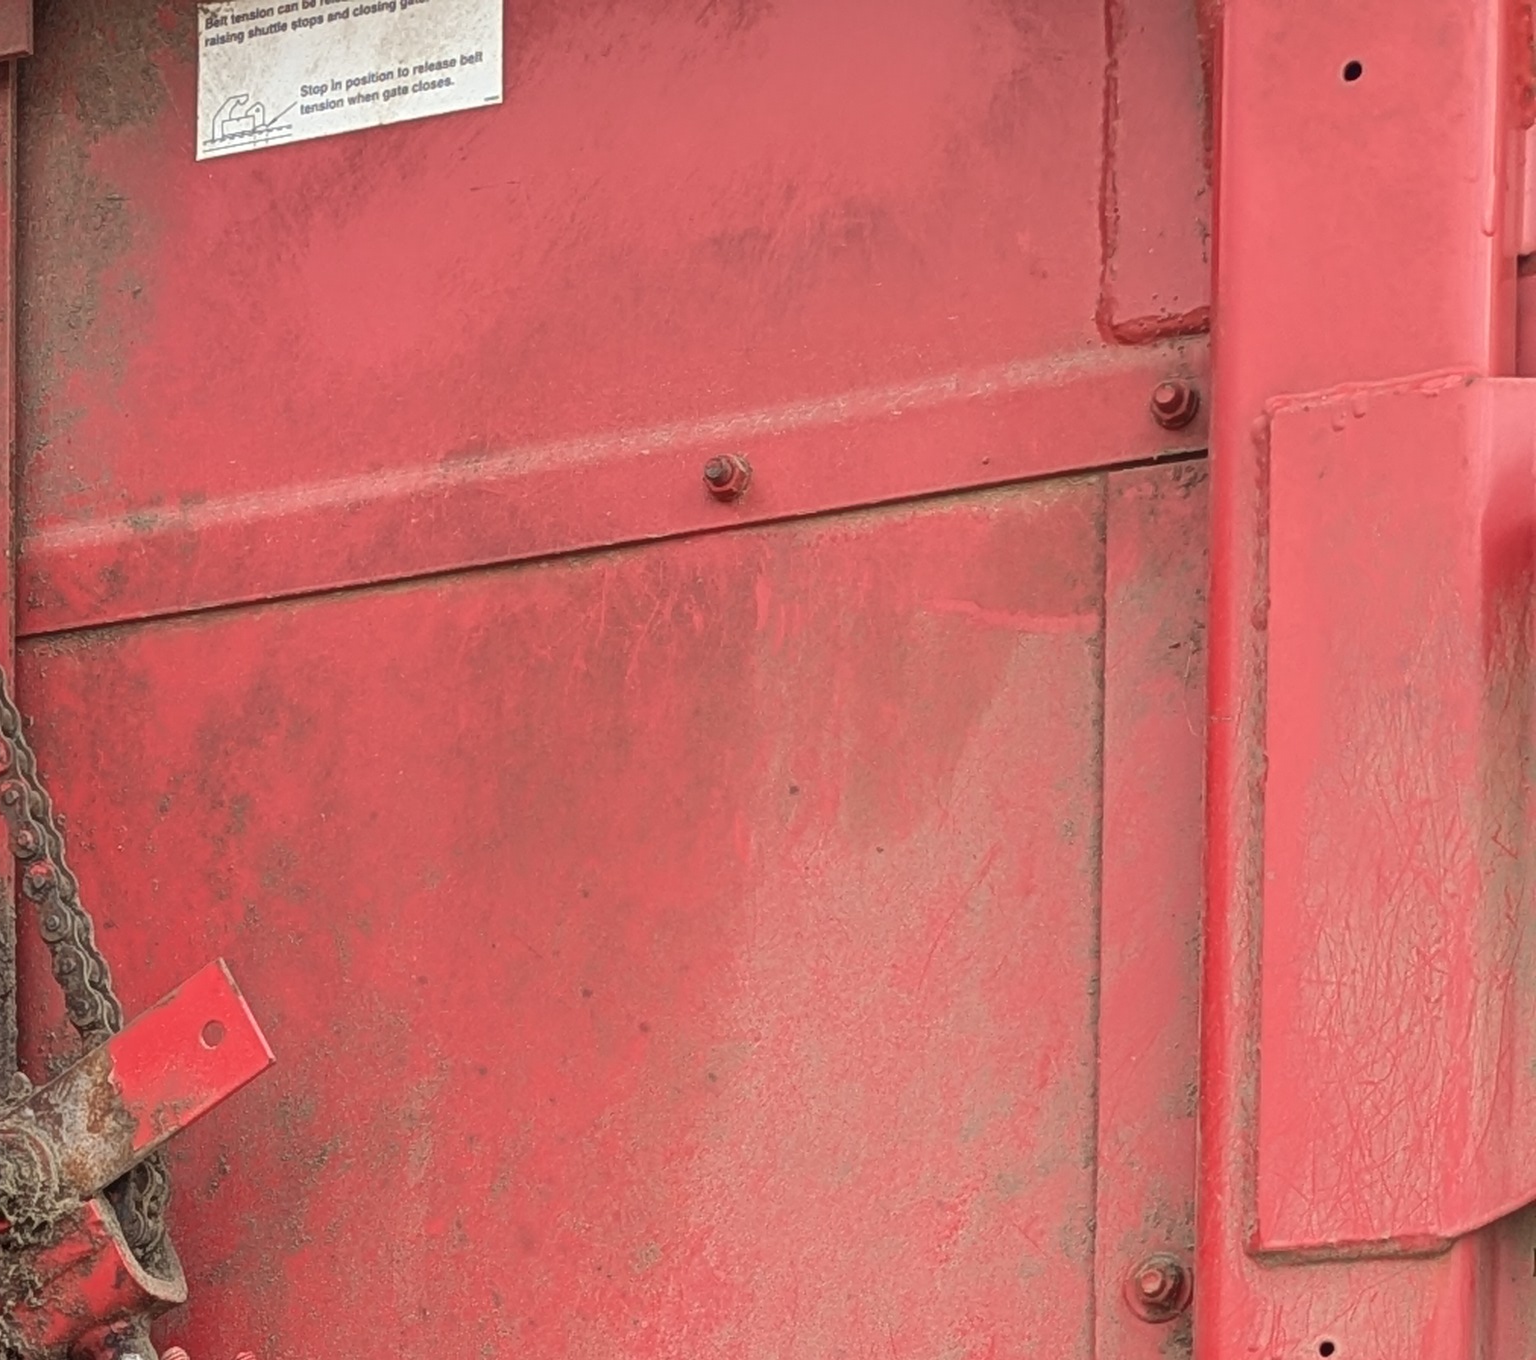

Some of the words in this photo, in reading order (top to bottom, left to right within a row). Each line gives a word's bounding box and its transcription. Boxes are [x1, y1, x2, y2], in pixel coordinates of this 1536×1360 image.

[205, 15, 228, 30] Belt
[231, 7, 275, 24] tension
[277, 2, 299, 15] can
[205, 31, 245, 47] raising
[248, 21, 288, 39] shuttle
[291, 15, 324, 30] stops
[327, 7, 350, 23] and
[352, 0, 396, 17] closing
[300, 84, 328, 98] Stop
[345, 71, 394, 92] position
[397, 66, 410, 79] to
[412, 58, 457, 76] release
[459, 51, 483, 66] belt
[300, 98, 344, 115] tension
[347, 91, 379, 107] when
[382, 84, 409, 102] gate
[411, 77, 455, 94] closes.
